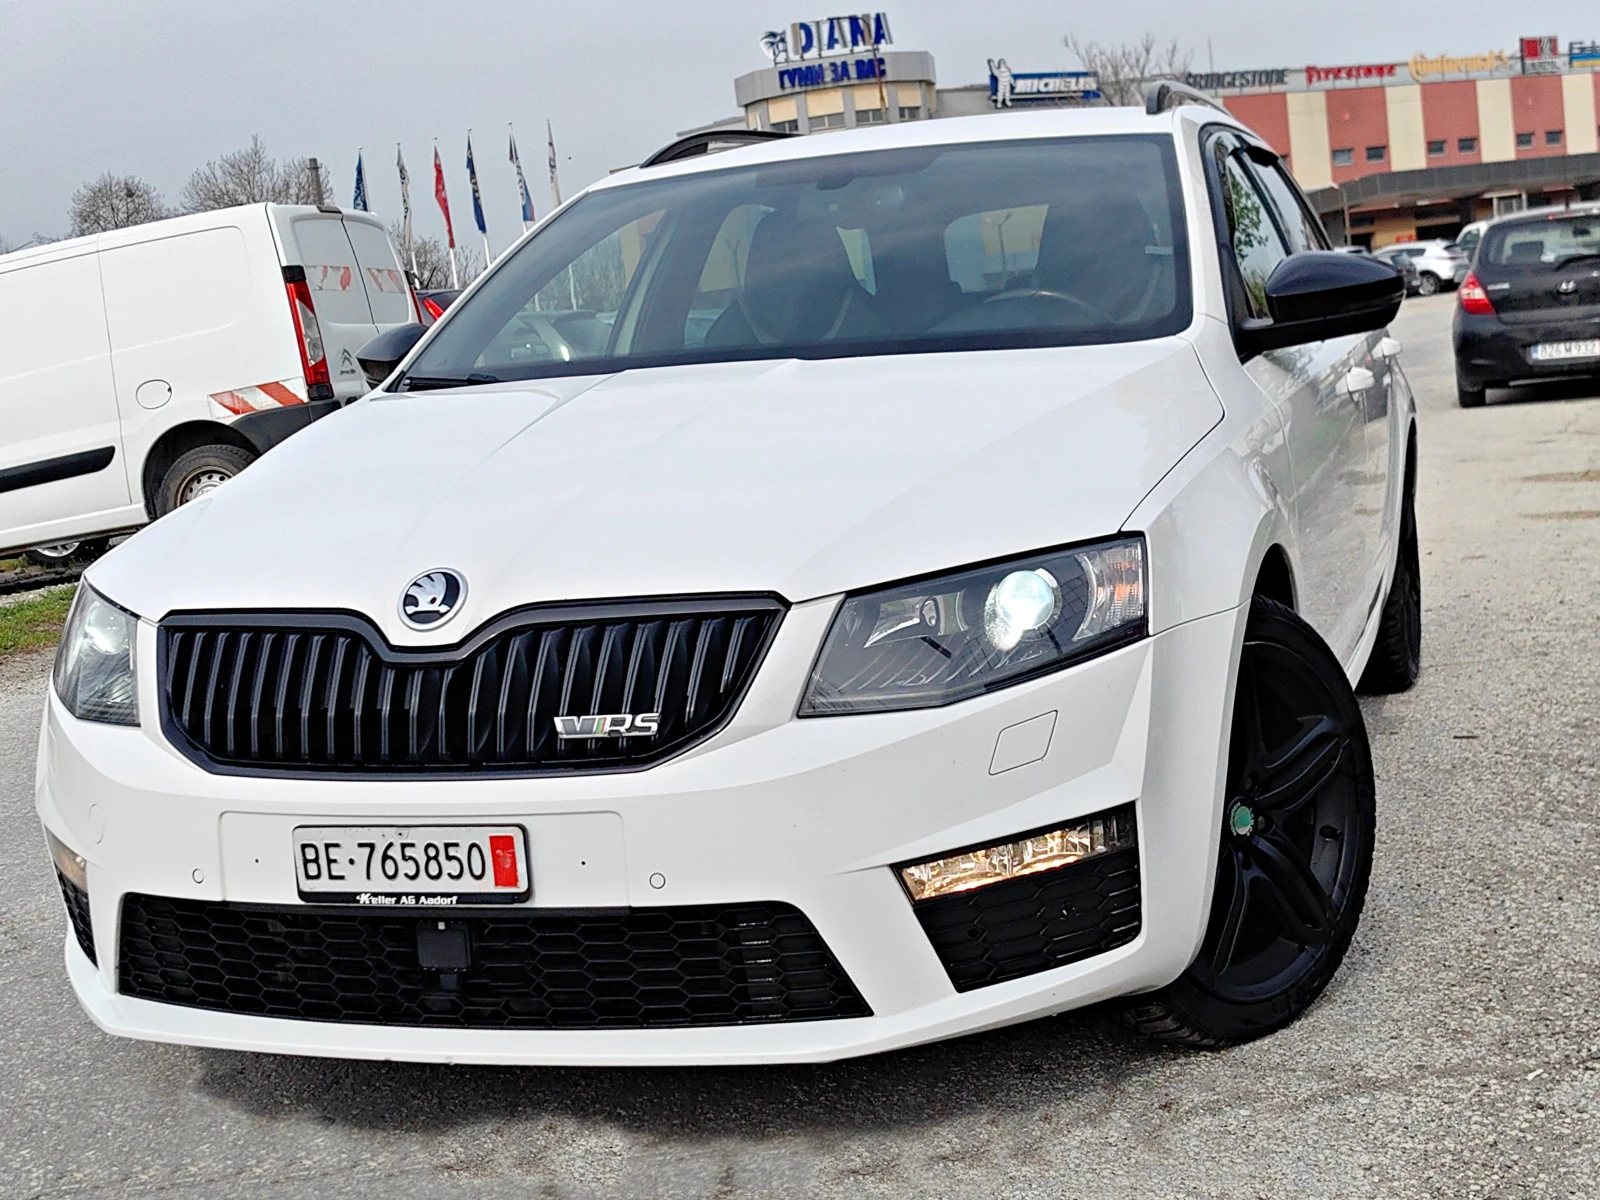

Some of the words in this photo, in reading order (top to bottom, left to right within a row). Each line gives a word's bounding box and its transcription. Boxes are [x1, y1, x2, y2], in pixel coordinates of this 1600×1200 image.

[791, 12, 893, 56] DIANA
[829, 60, 851, 82] ЗА
[355, 892, 398, 905] Keller
[400, 895, 416, 905] AG
[419, 895, 459, 905] Aadorf
